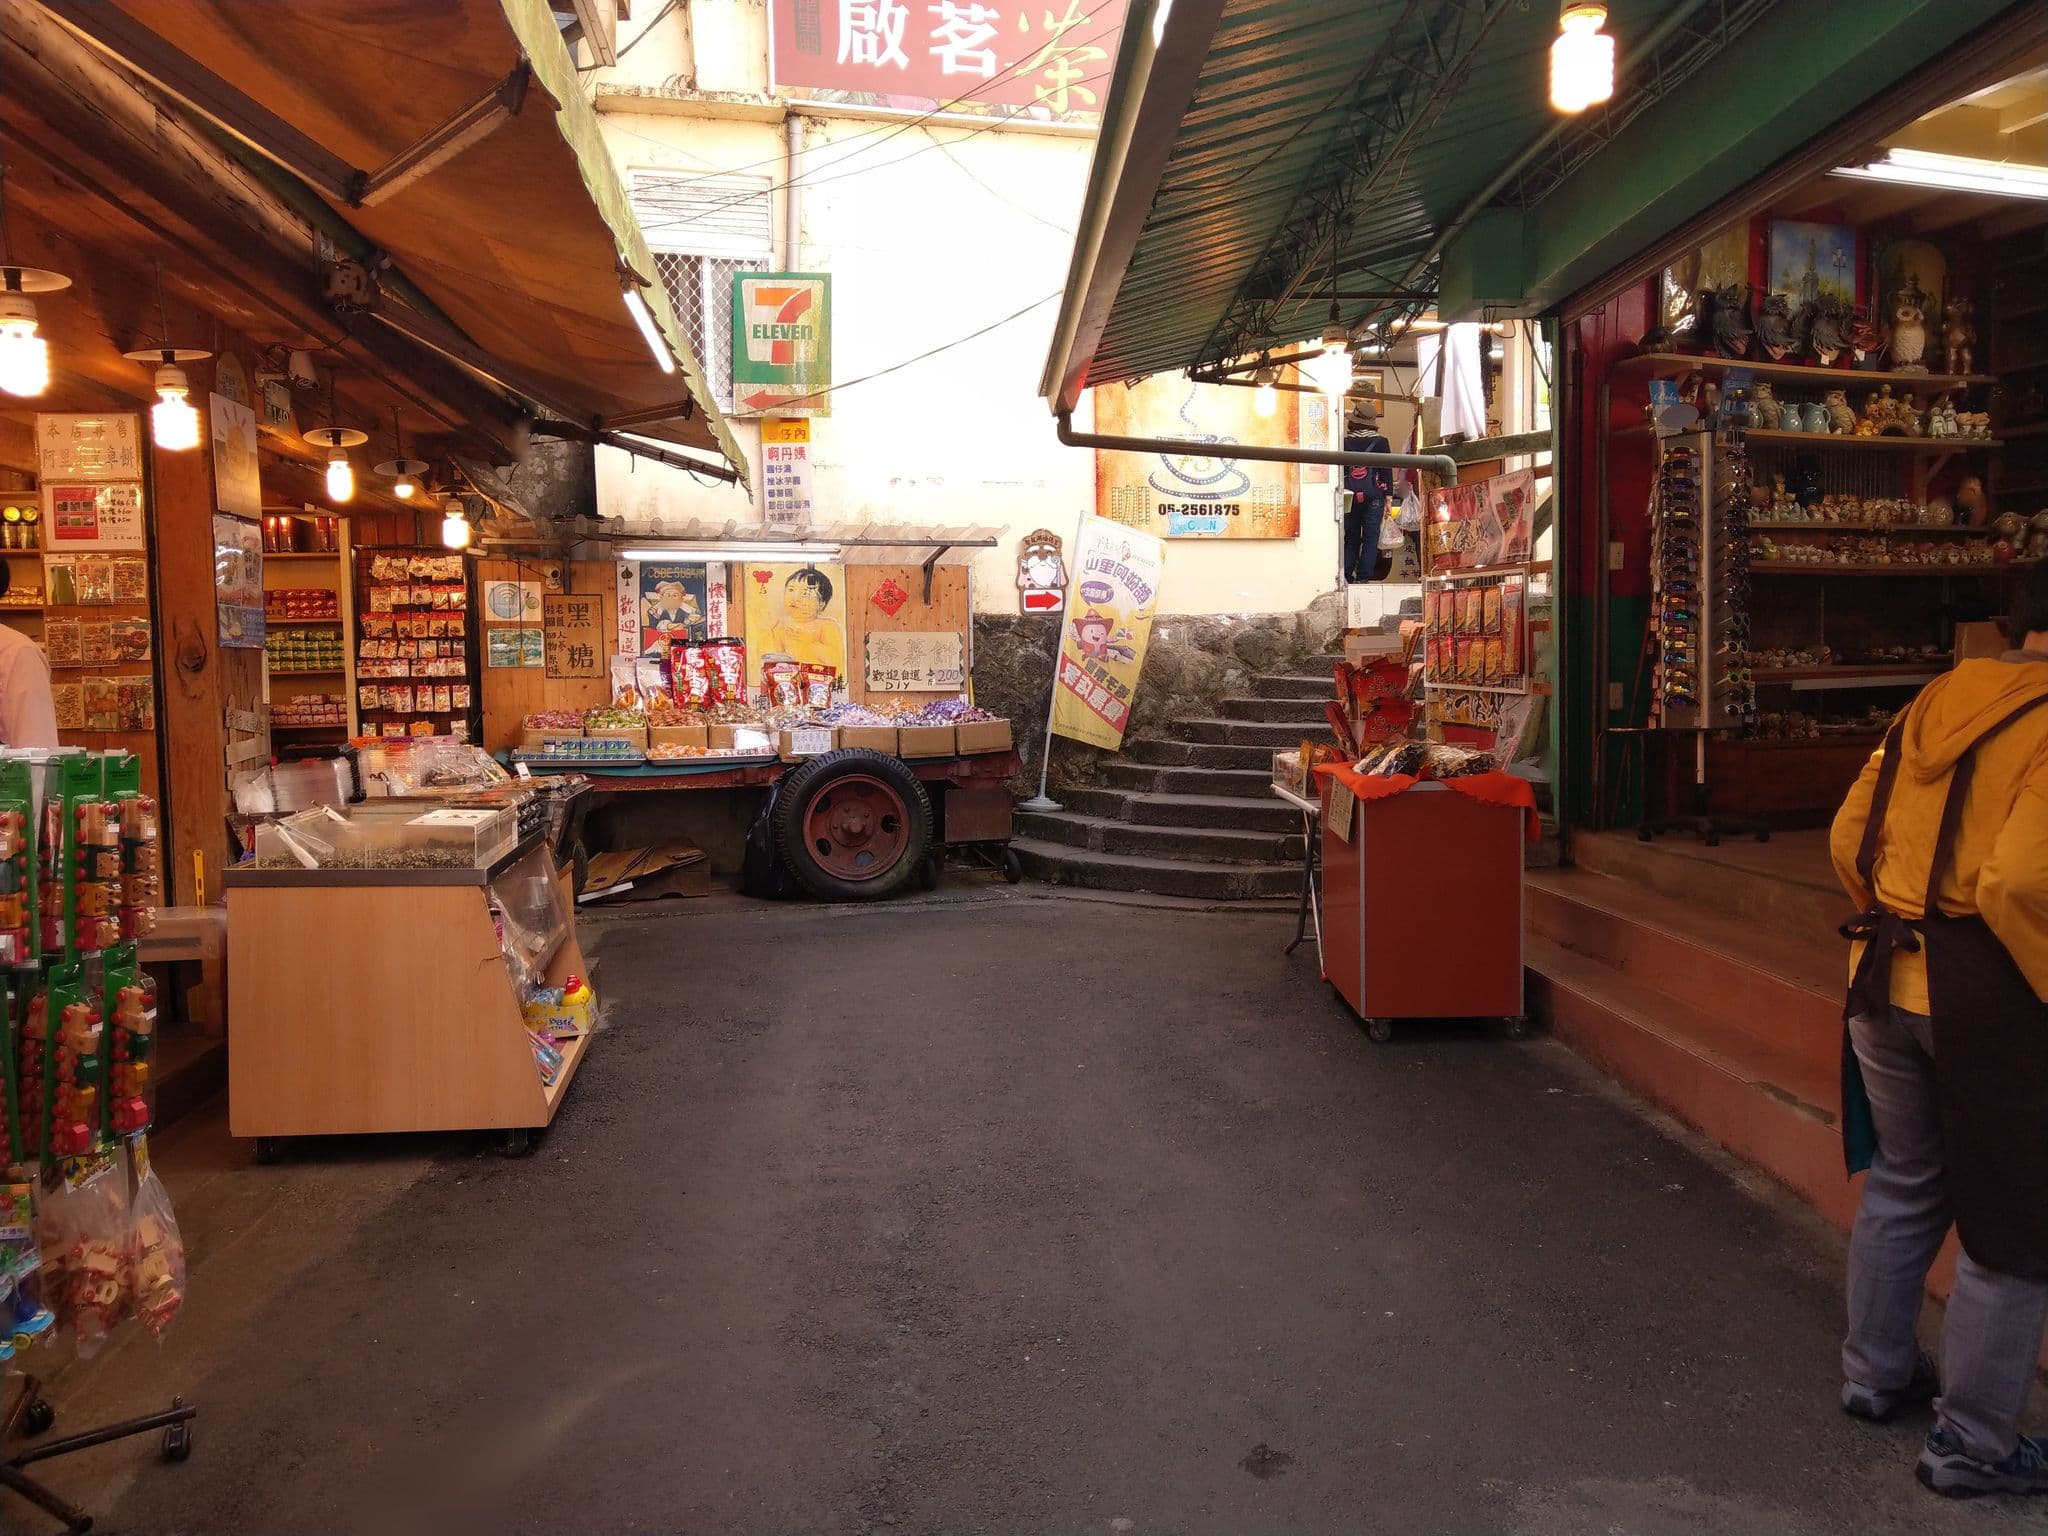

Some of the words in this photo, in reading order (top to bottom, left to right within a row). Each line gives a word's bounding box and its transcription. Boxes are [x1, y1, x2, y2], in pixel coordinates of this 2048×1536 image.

[836, 0, 1108, 115] 啟茗茶
[755, 287, 811, 364] 7
[768, 427, 806, 440] 仔內
[1112, 484, 1151, 526] 咖
[1158, 503, 1240, 516] 05-2561875
[567, 603, 594, 669] 黑糖
[620, 595, 637, 662] 歡迎選
[872, 668, 922, 681] 歡迎自選
[885, 681, 910, 690] DIY
[937, 669, 960, 683] 200
